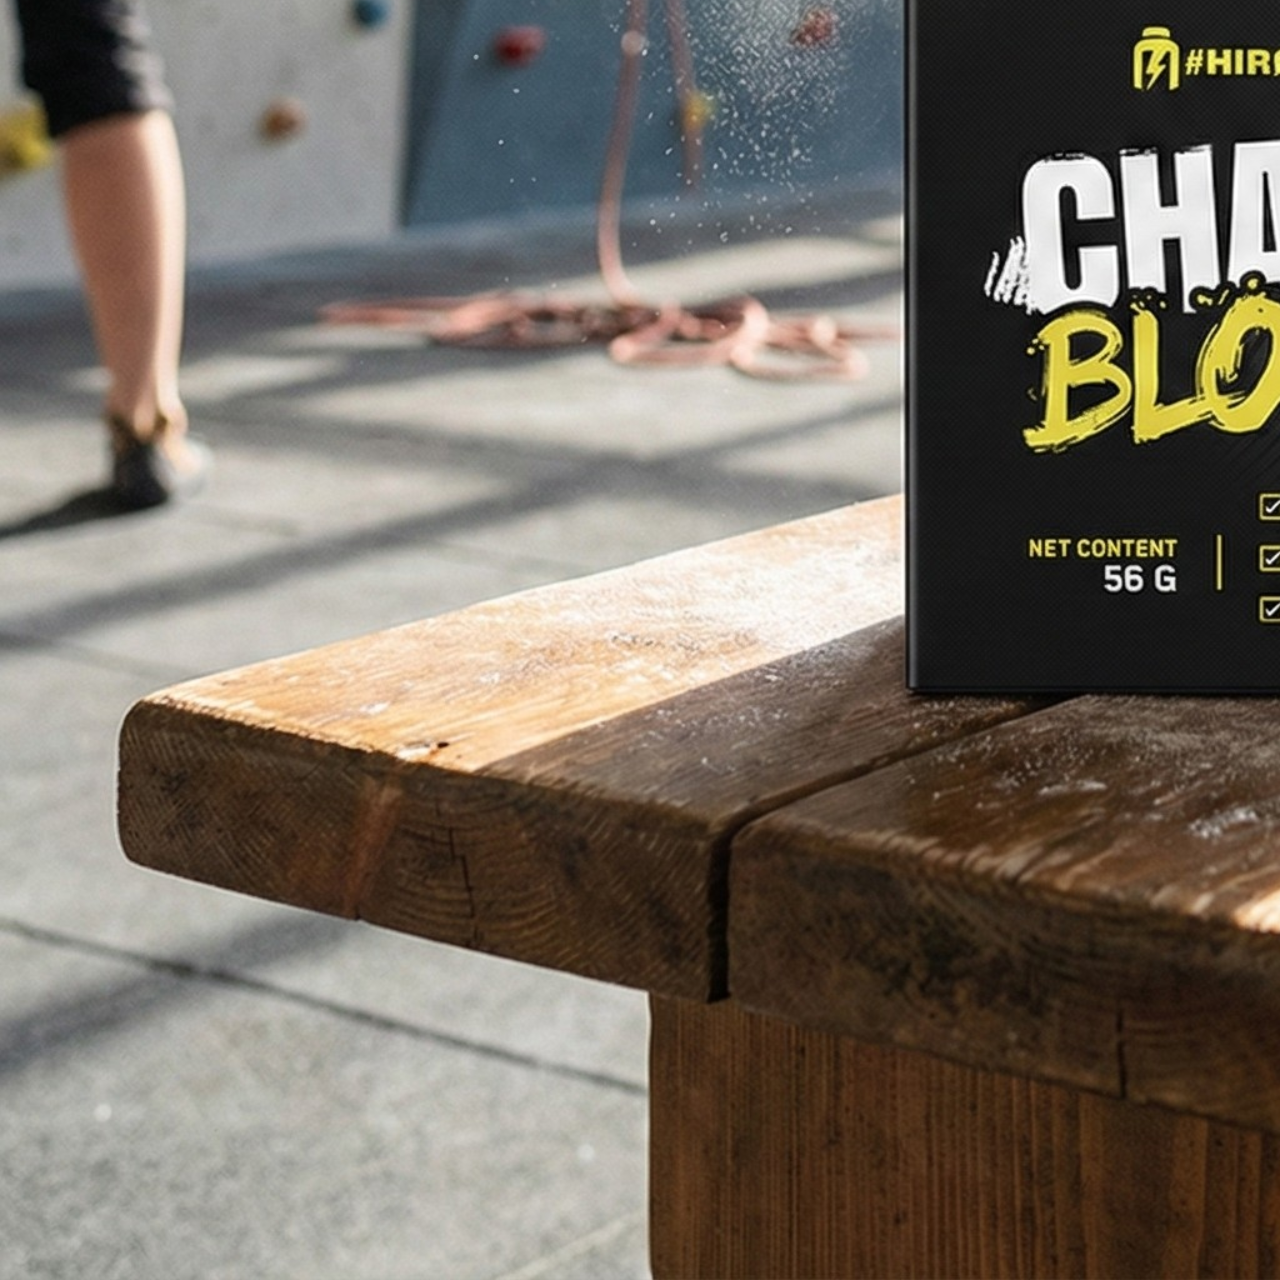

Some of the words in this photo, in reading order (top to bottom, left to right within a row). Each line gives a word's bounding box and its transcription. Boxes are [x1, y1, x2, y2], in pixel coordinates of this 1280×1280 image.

[1029, 538, 1072, 558] NET
[1076, 538, 1178, 558] CONTENT
[1104, 564, 1144, 592] 56
[1154, 564, 1177, 592] G
